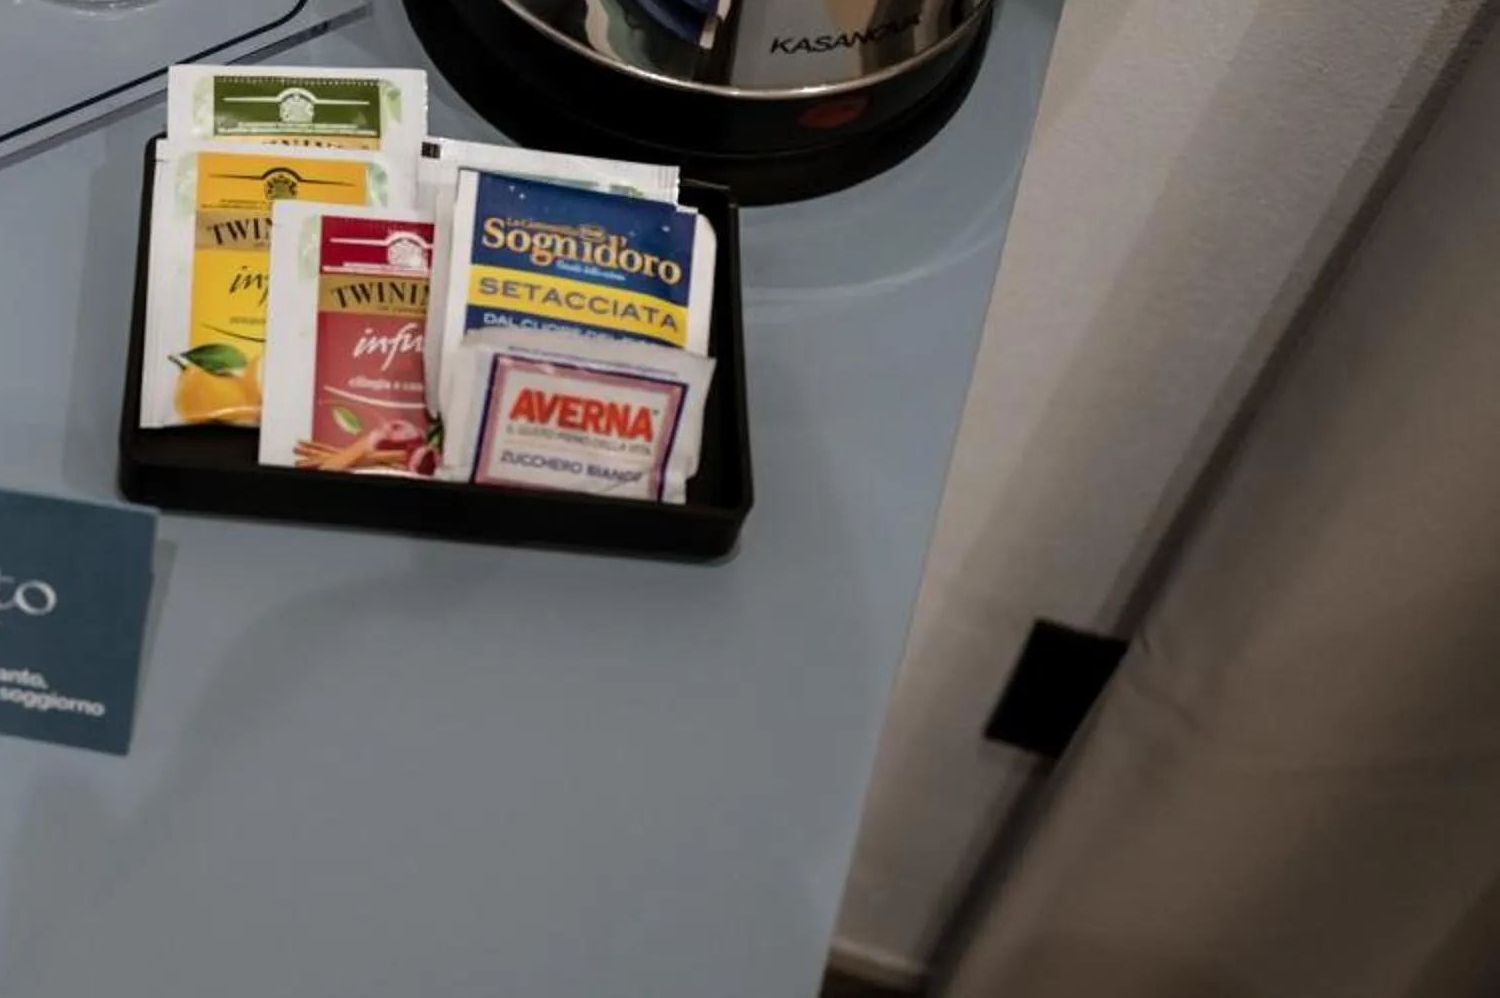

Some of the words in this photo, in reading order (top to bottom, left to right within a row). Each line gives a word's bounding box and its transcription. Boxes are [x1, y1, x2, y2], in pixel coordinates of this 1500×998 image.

[769, 12, 921, 54] KASANOA
[478, 276, 678, 333] SETACCIATA
[509, 387, 653, 443] AVERNA
[501, 450, 583, 474] ZUCCHERO
